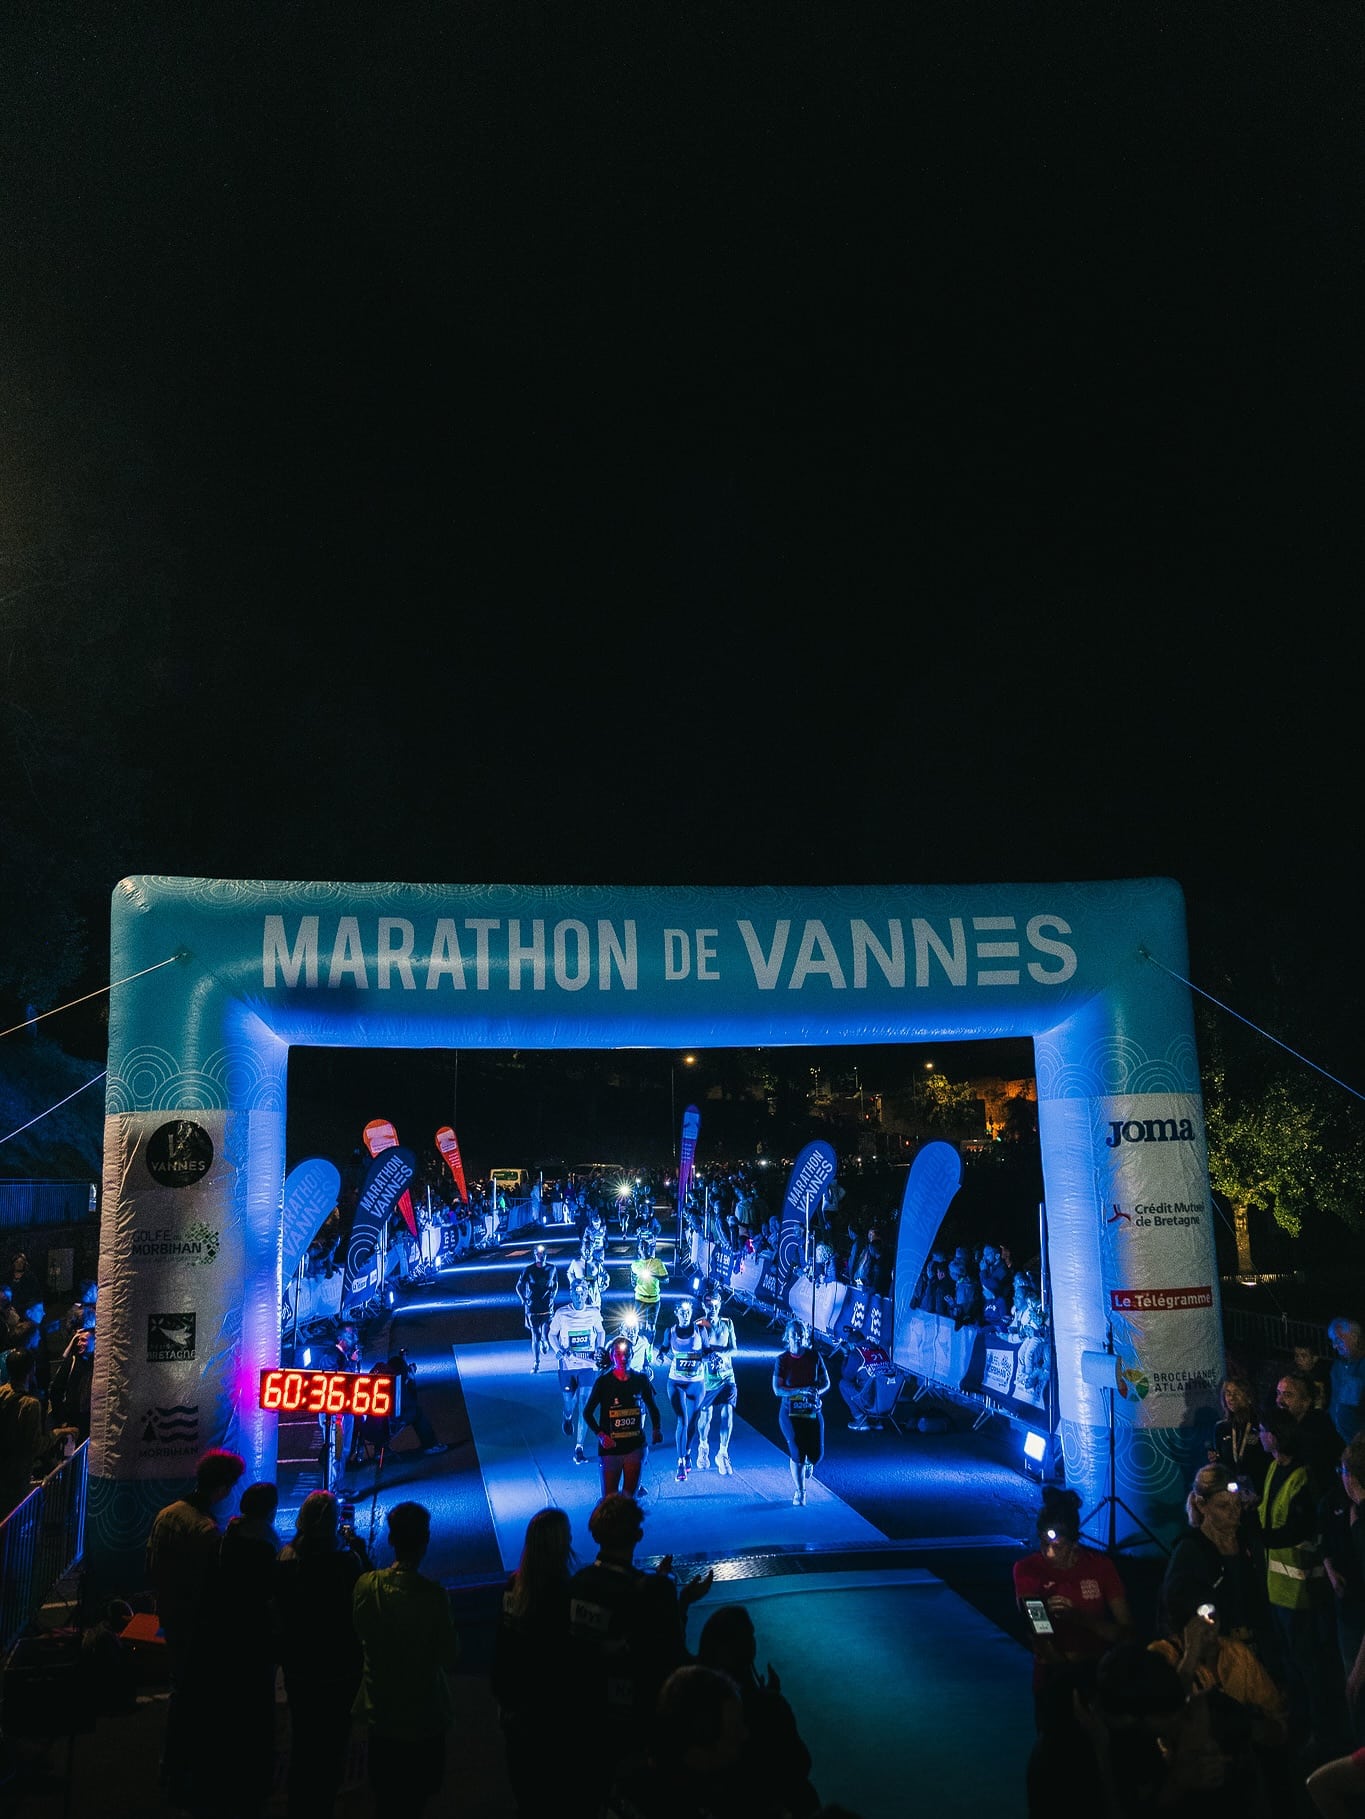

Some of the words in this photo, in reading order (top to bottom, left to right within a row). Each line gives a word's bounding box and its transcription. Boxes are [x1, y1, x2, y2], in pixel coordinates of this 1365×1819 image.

[262, 914, 639, 991] MARATHON
[664, 928, 721, 981] DE
[736, 914, 1078, 990] VANNES
[151, 1159, 206, 1172] VANNES
[787, 1150, 825, 1207] MARATHON
[359, 1154, 404, 1212] MARATHON
[369, 1164, 414, 1219] VANNES
[283, 1164, 328, 1236] ARATHON
[1135, 1203, 1173, 1215] Crédit
[283, 1180, 337, 1258] VANNES
[1136, 1216, 1152, 1227] de
[1154, 1216, 1200, 1228] Bretagne
[132, 1242, 202, 1256] MORBIHAN
[1114, 1296, 1132, 1308] Le
[1135, 1292, 1211, 1309] Télégramme
[263, 1373, 391, 1415] 60:36.66
[614, 1417, 636, 1428] 8302
[139, 1446, 199, 1458] MORBIHAN
